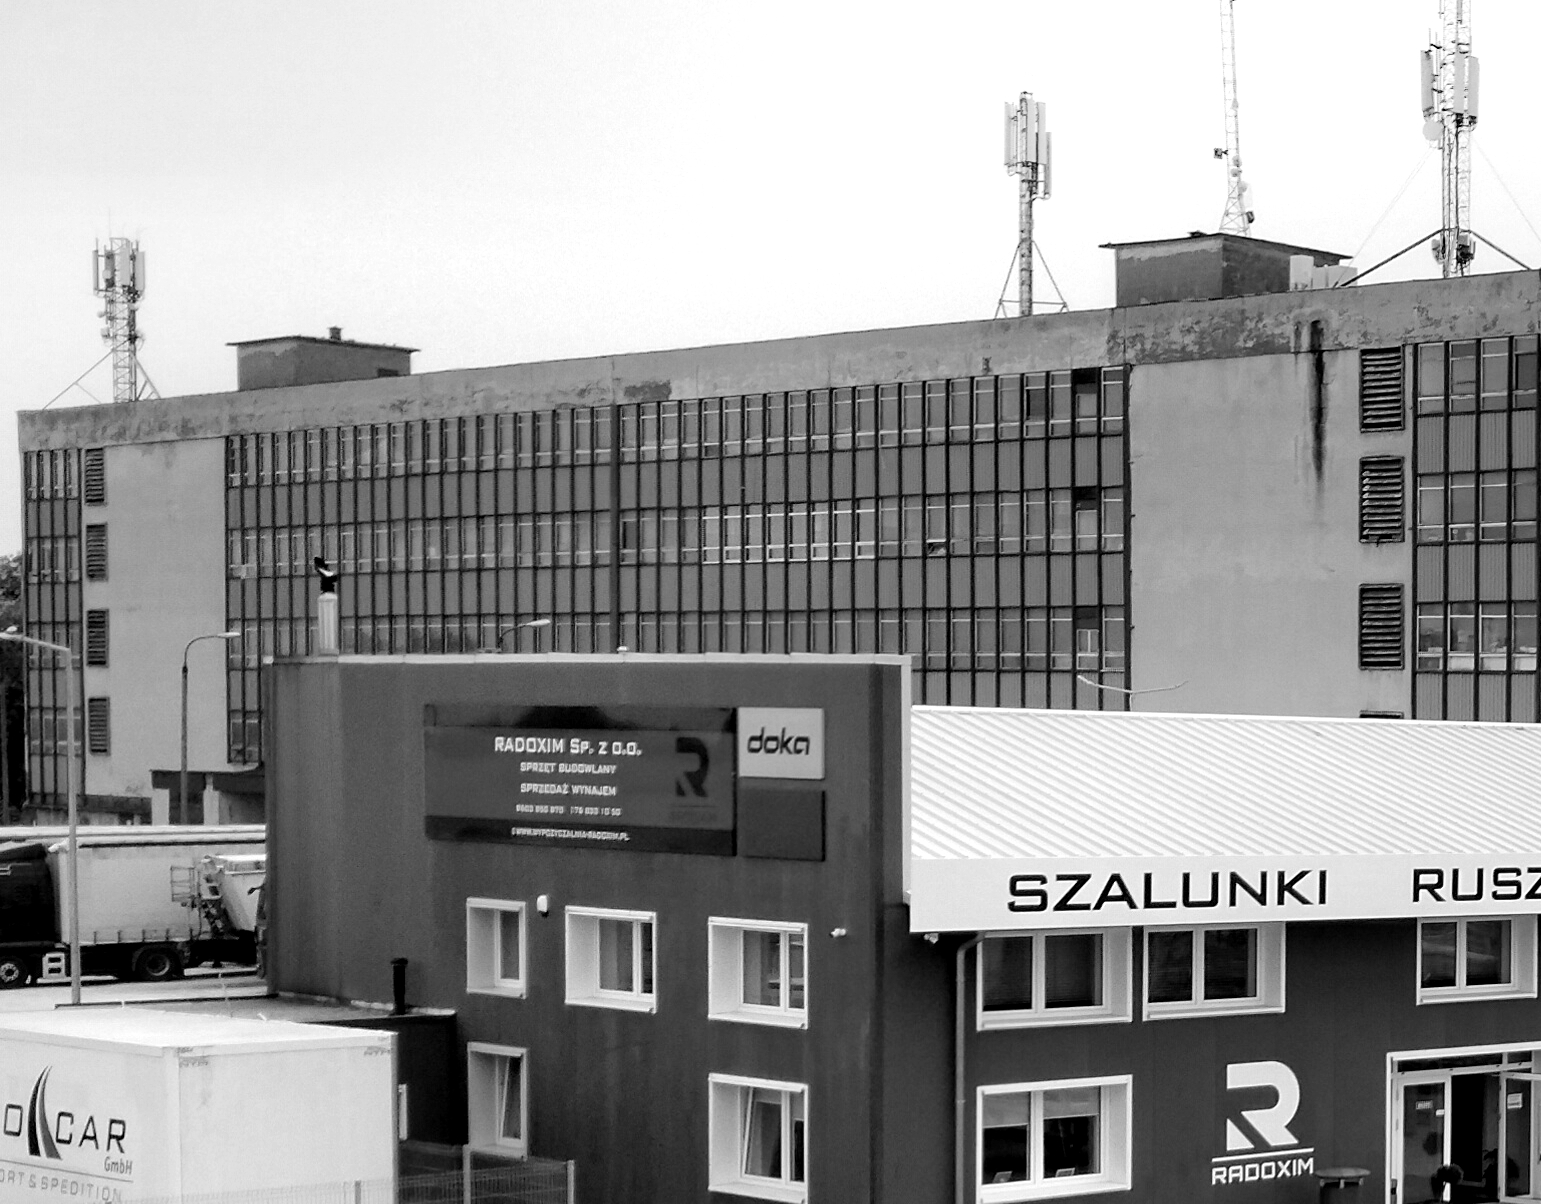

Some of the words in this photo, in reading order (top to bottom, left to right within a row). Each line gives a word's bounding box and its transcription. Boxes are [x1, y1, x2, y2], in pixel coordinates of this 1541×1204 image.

[494, 736, 565, 754] RADOXIM
[747, 728, 811, 755] doka
[558, 763, 617, 774] BUDOWLANY
[571, 785, 617, 796] WYNAJEM
[1008, 869, 1327, 912] SZALUNKI
[1226, 1061, 1300, 1151] R
[55, 1111, 126, 1153] CAR
[104, 1156, 133, 1176] GmbH
[1211, 1157, 1314, 1186] RADOXIM
[40, 1176, 122, 1202] SPEDITION
